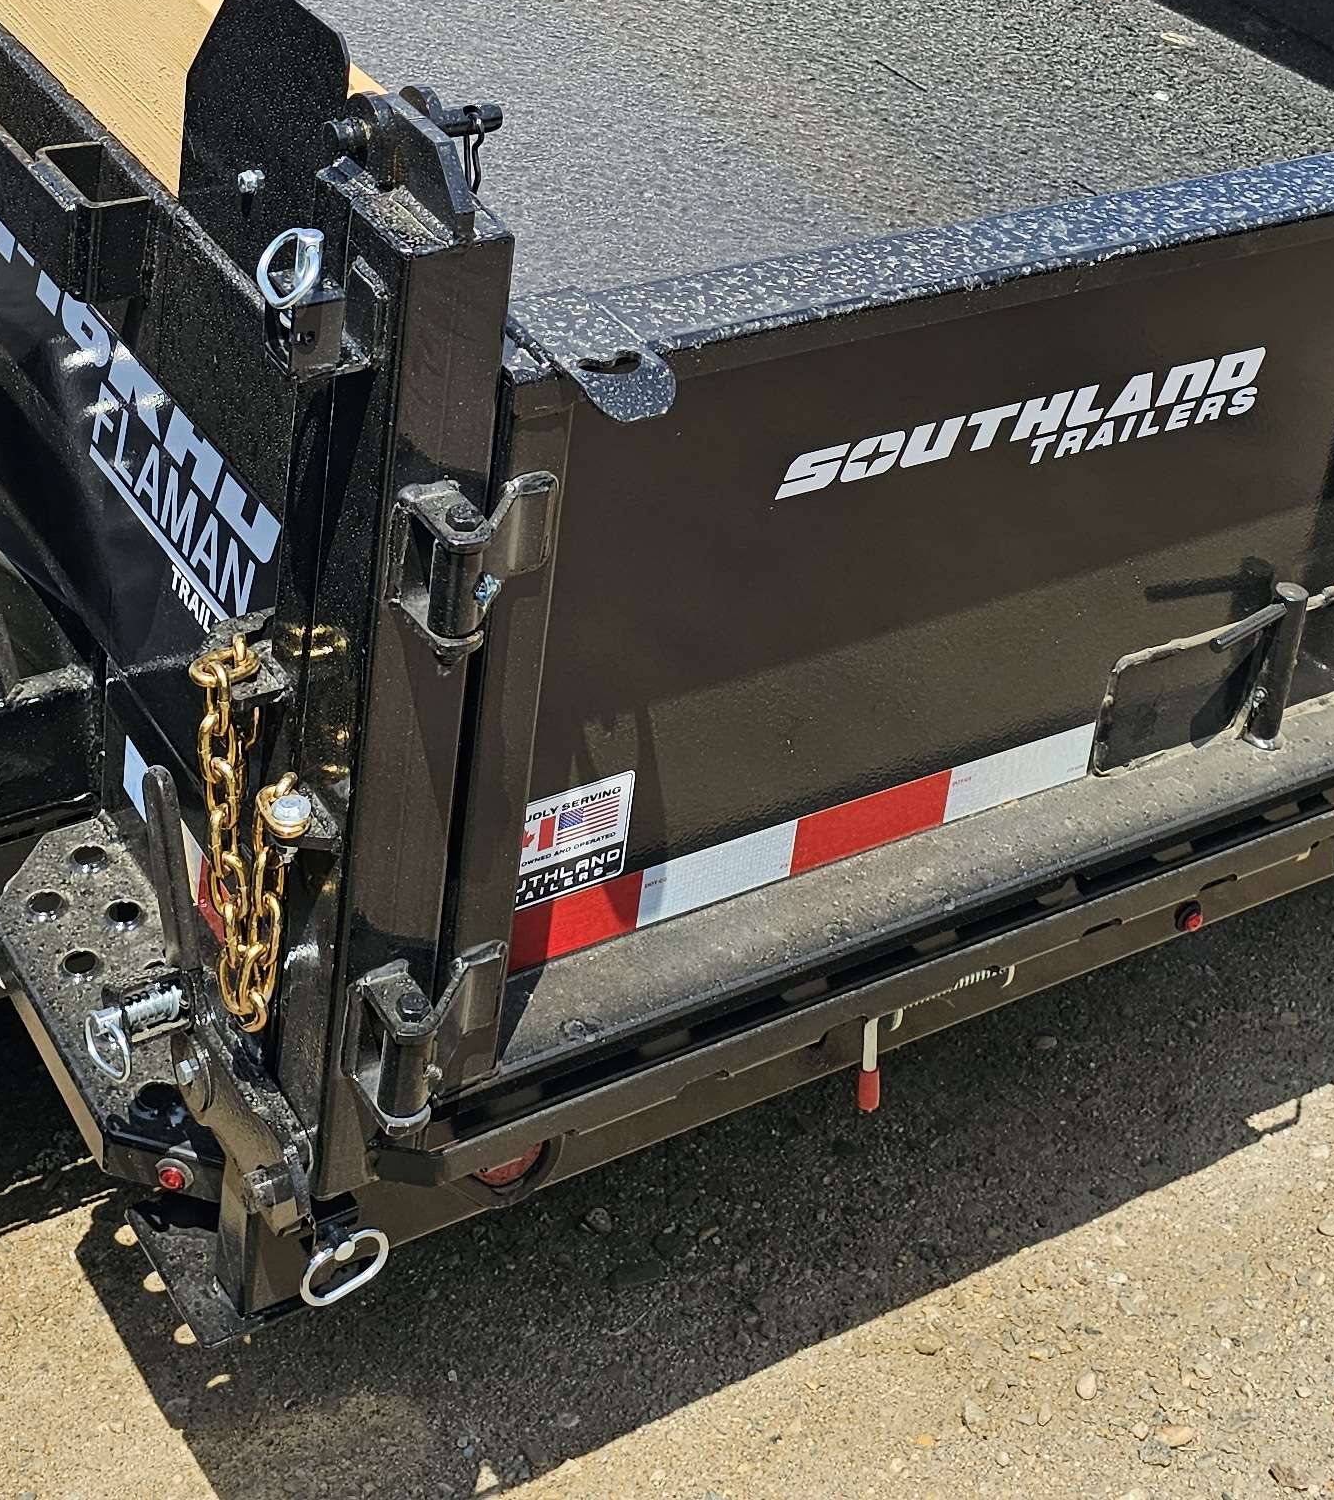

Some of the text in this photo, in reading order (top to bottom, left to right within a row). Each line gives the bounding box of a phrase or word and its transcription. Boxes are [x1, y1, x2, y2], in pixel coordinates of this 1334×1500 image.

[775, 346, 1266, 500] SOUTHLAND
[1030, 386, 1259, 464] TRAILERS
[92, 381, 256, 618] FLAMAN
[171, 564, 219, 635] TRAIL
[562, 786, 622, 812] SERVING
[521, 831, 616, 867] OWNED AND OPERATED
